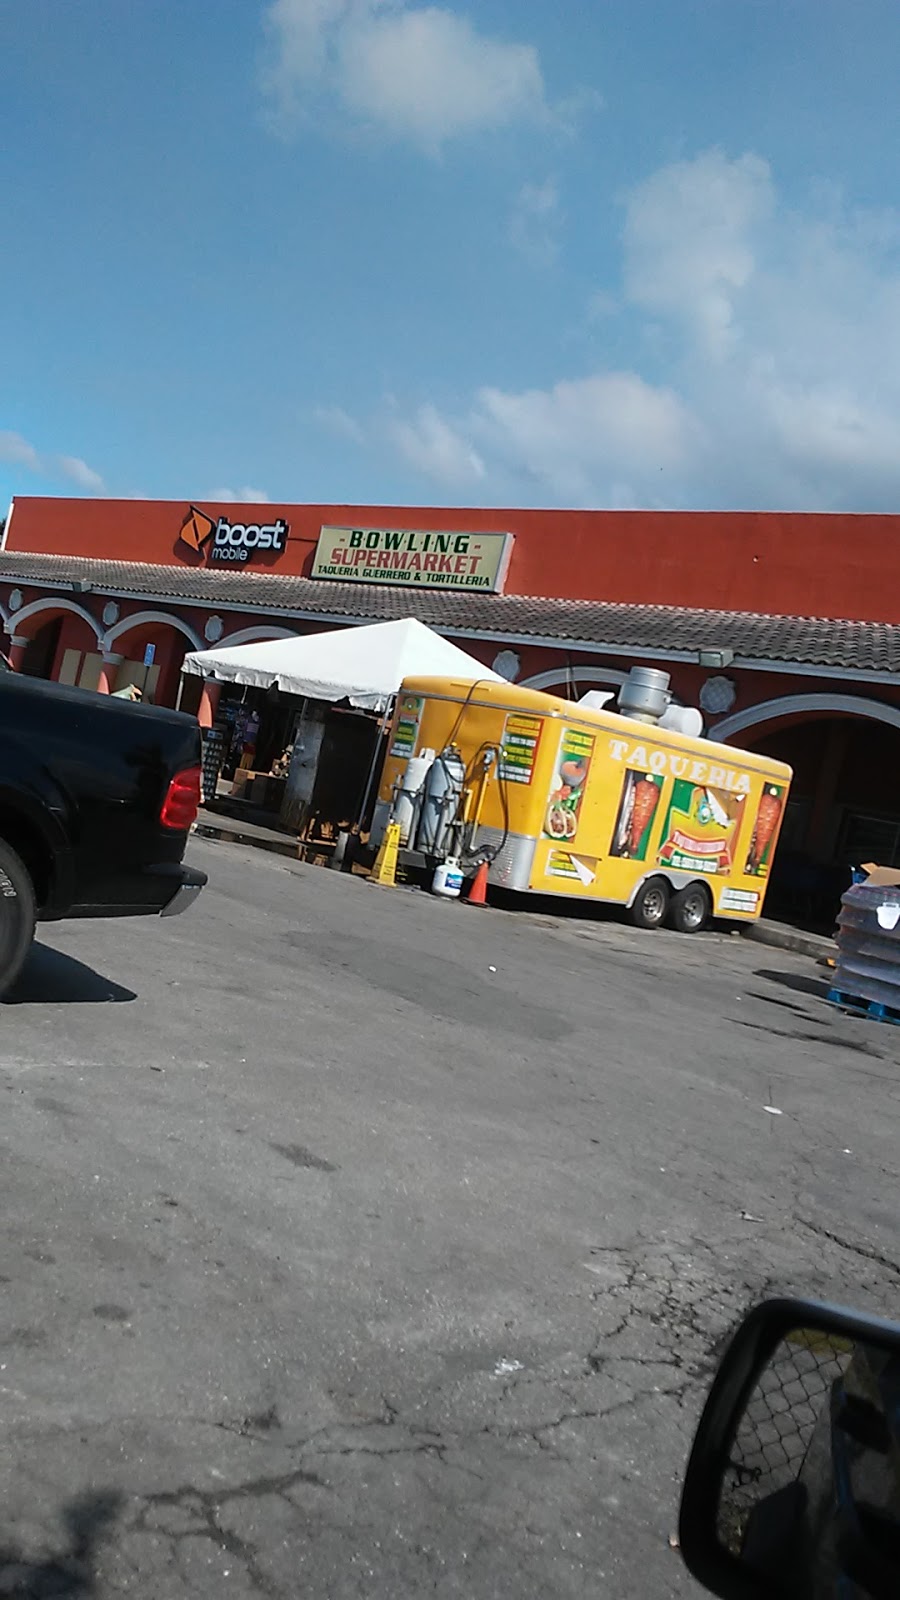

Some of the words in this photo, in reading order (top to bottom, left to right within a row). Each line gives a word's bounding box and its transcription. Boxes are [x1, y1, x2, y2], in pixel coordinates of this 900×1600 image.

[215, 518, 284, 549] boost
[212, 546, 248, 561] mobile
[330, 548, 482, 574] SUPERMARKET
[318, 565, 359, 576] TAQUERIA
[362, 570, 411, 580] GUERRERO
[426, 573, 490, 586] TORTILLERIA
[609, 739, 750, 795] TAQUERIA
